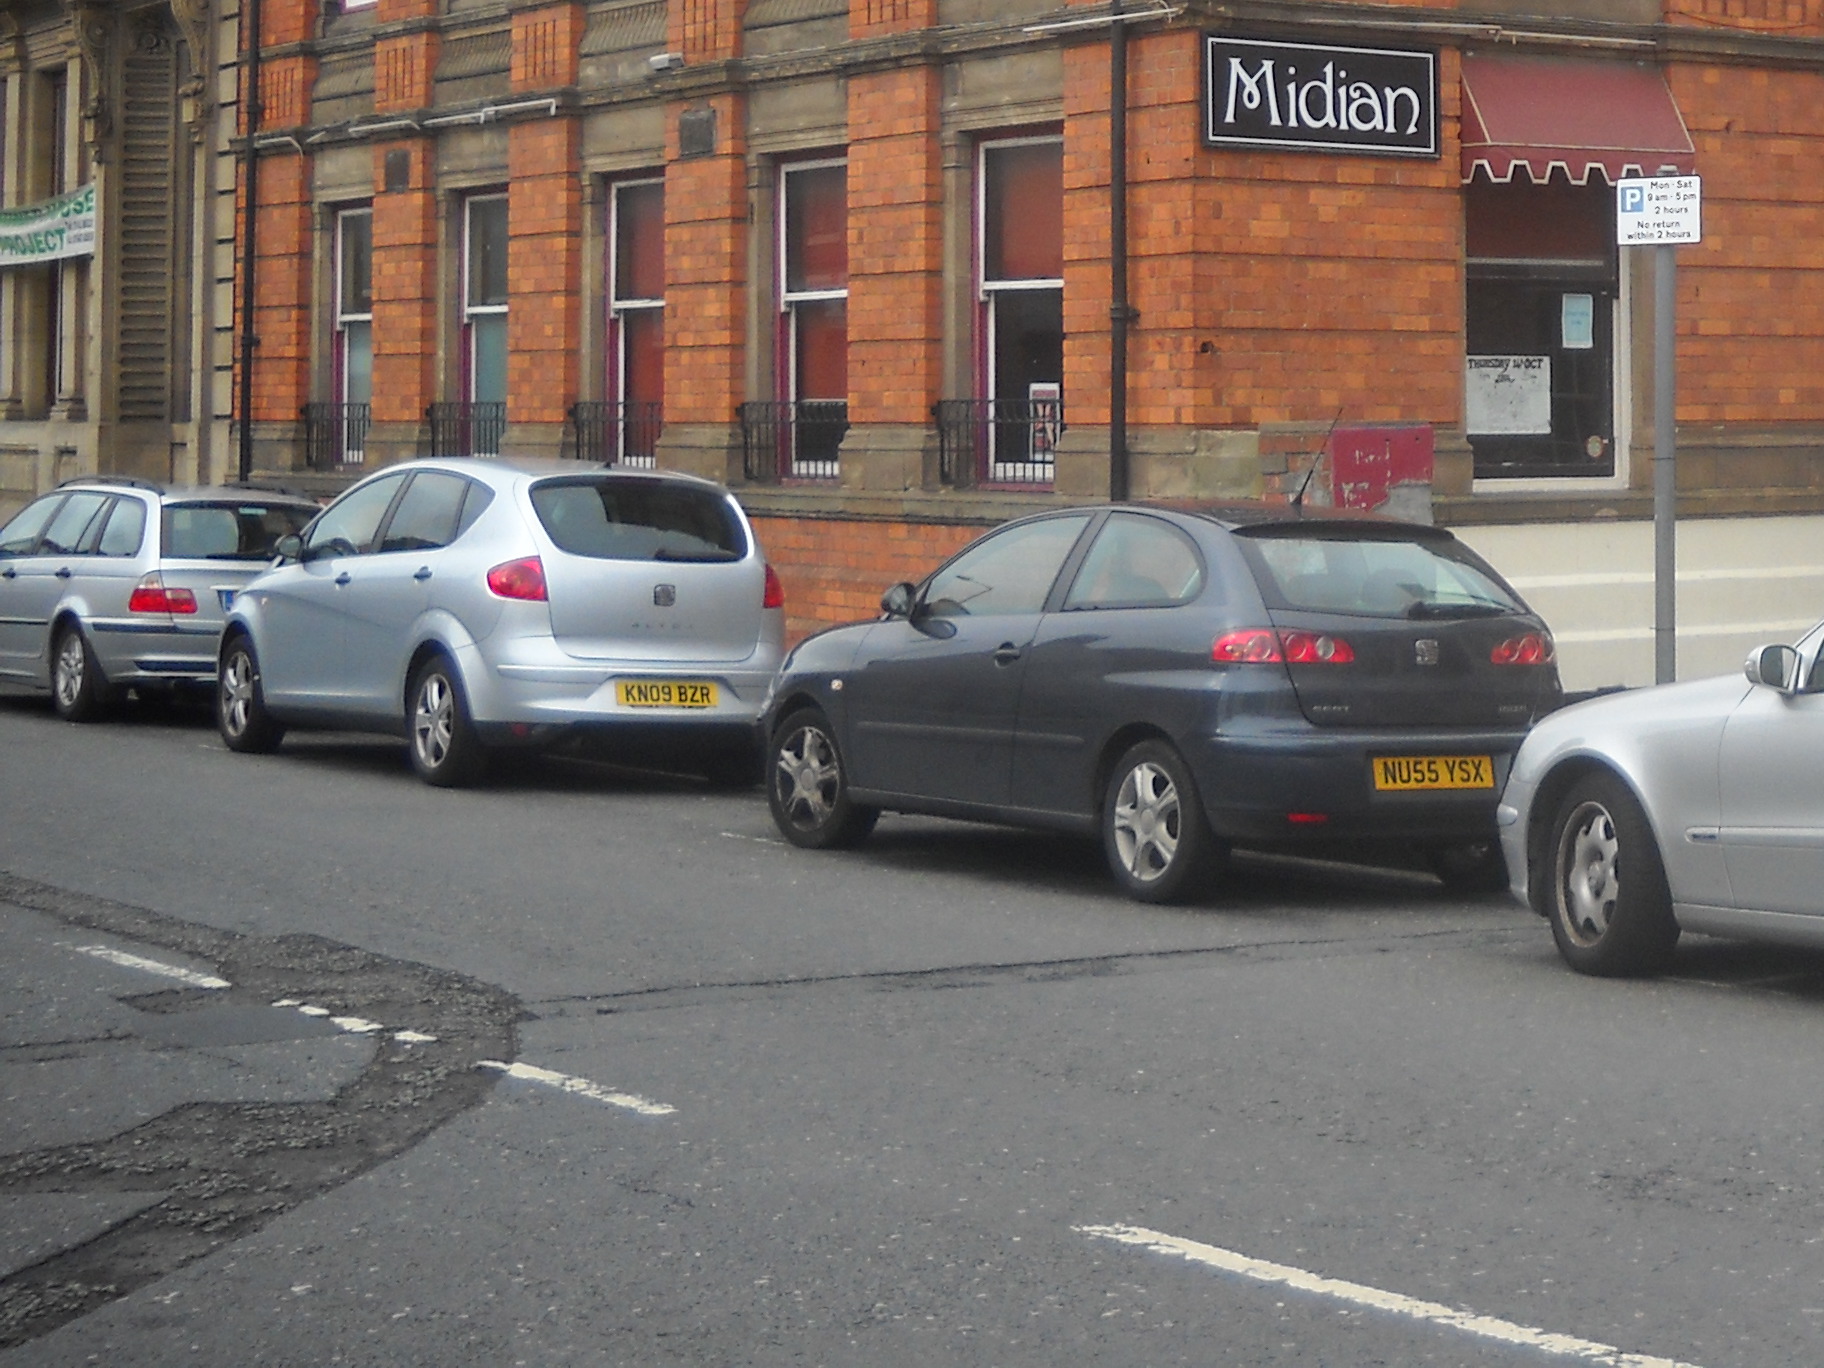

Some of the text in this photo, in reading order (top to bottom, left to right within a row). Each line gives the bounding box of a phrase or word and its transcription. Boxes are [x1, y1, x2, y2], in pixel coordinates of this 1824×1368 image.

[1223, 57, 1421, 135] Midian
[1650, 181, 1670, 189] Mon
[1676, 180, 1693, 188] Sat
[1625, 188, 1641, 211] P
[1654, 206, 1688, 214] 2 hours
[1627, 231, 1655, 240] within
[1666, 231, 1691, 239] hours
[625, 684, 711, 703] KN09 BZR
[1383, 759, 1484, 784] NU55 YSX
